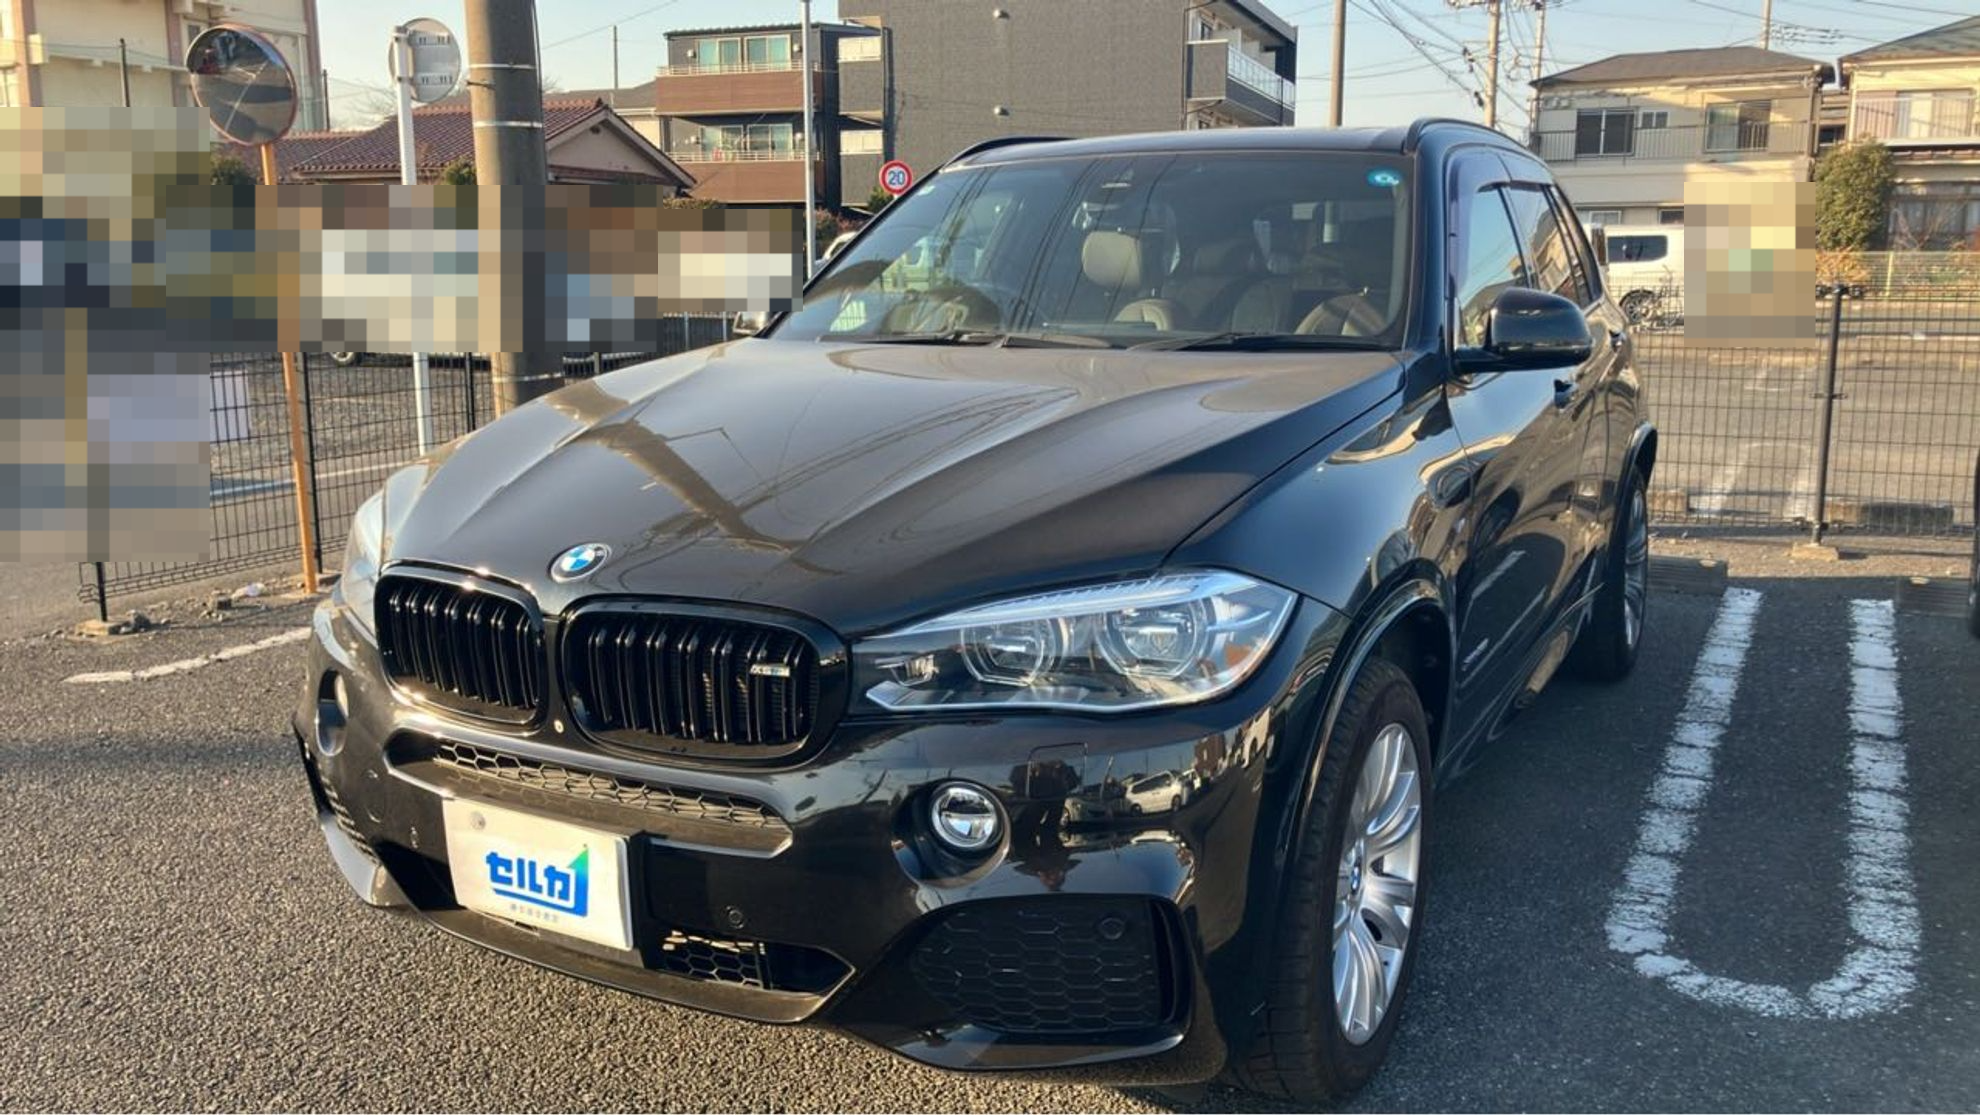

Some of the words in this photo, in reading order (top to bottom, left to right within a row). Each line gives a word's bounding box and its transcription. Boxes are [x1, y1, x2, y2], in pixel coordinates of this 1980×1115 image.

[888, 170, 905, 186] 20
[485, 851, 571, 902] セルカ
